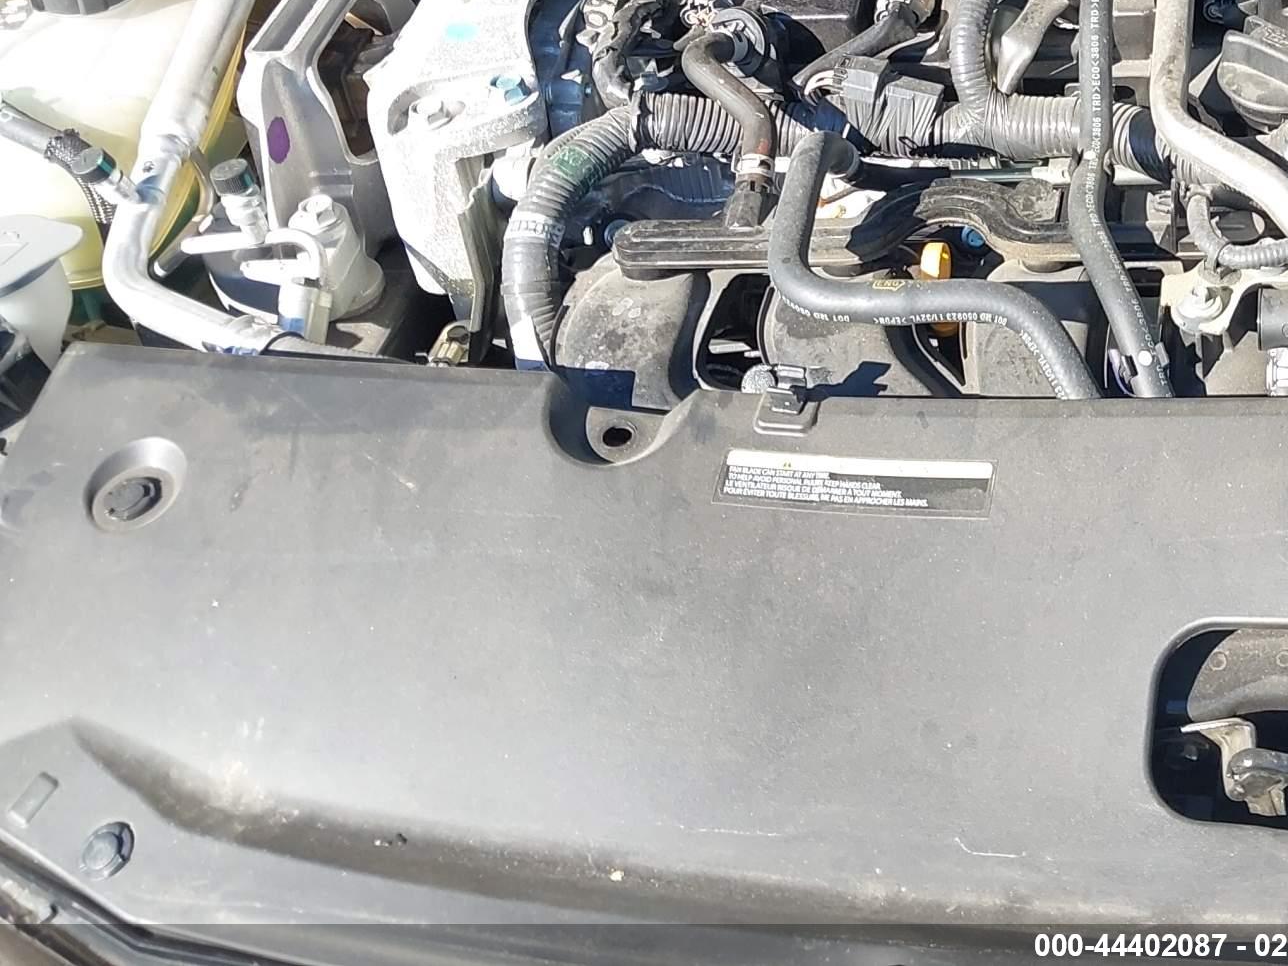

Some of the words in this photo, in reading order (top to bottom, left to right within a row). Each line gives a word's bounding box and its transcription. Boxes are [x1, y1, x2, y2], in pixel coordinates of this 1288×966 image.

[734, 481, 776, 490] VENTILATEUR
[777, 484, 800, 493] RISQUE
[772, 476, 802, 485] PERSONAL
[839, 480, 861, 489] HANDS
[766, 490, 787, 499] TOUTE
[854, 497, 893, 506] APPROCHER
